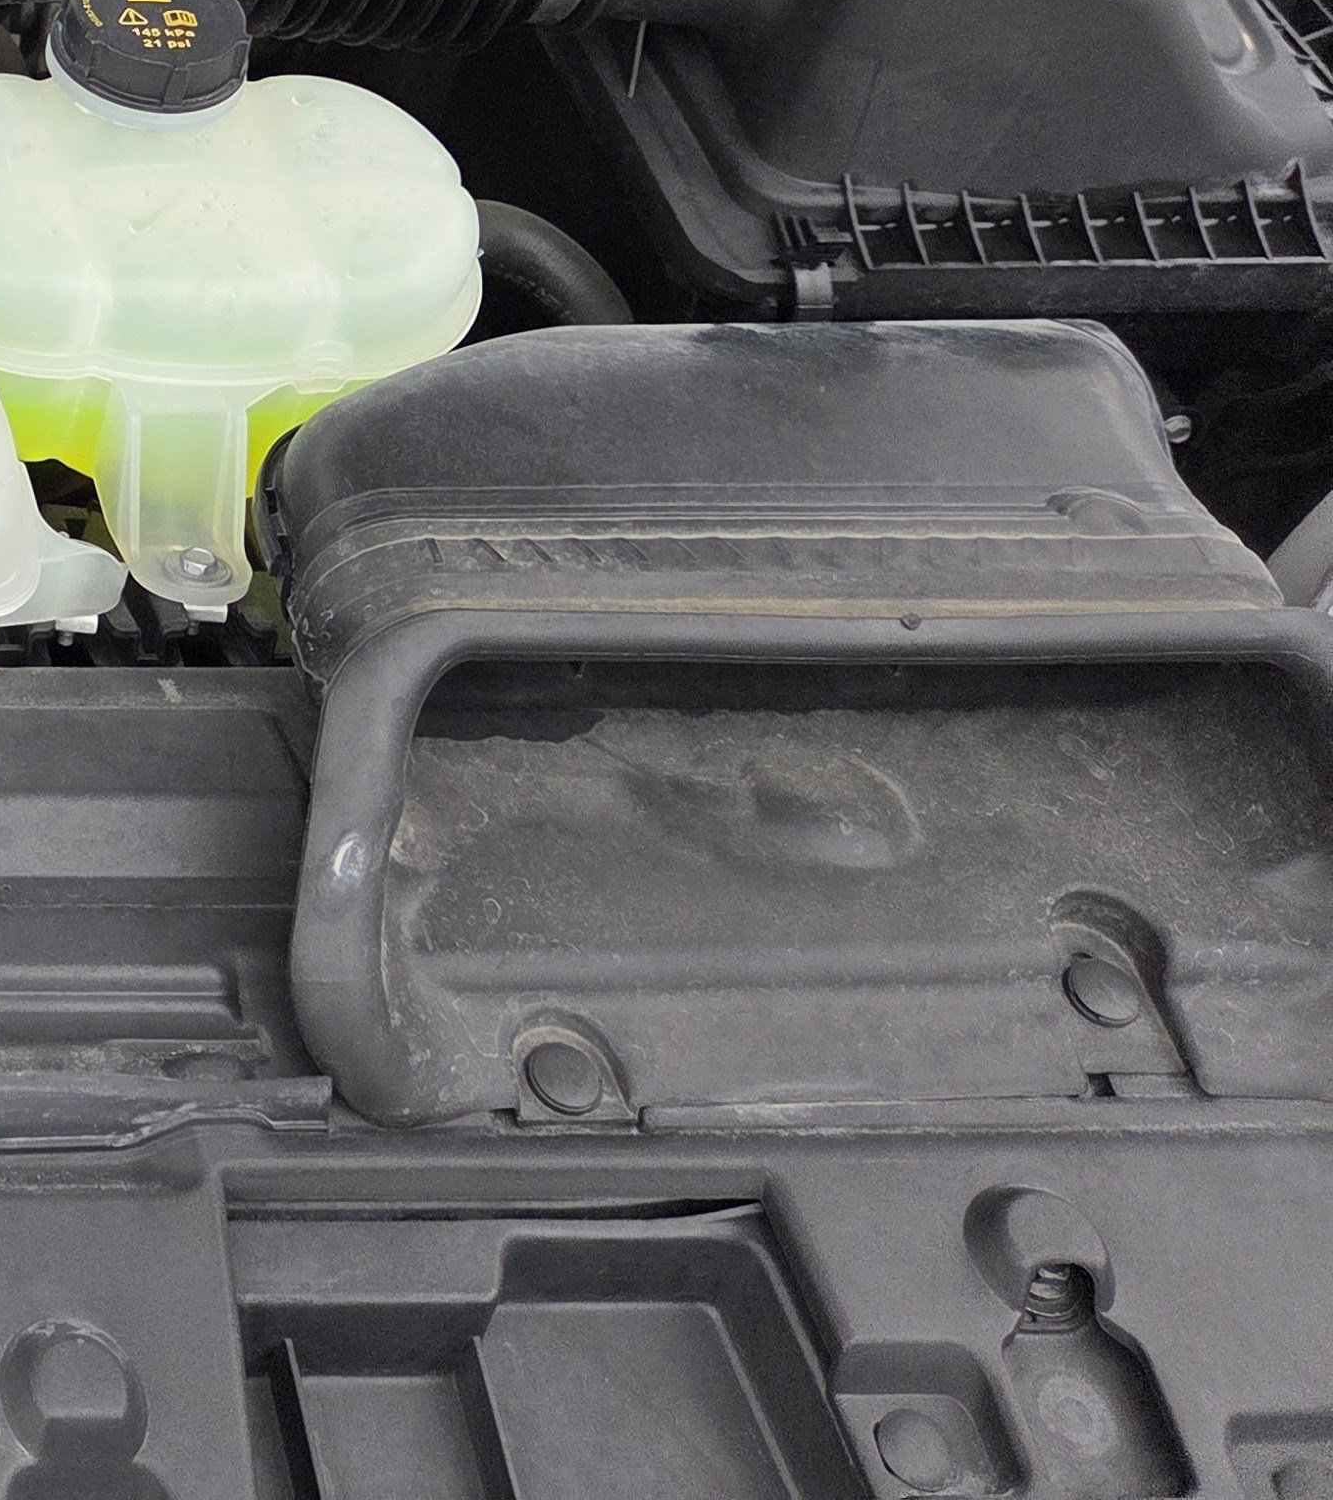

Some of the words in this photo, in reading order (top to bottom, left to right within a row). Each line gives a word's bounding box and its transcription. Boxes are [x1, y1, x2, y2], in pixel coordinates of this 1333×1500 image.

[131, 27, 161, 37] 145
[164, 27, 196, 37] kPa
[143, 38, 162, 48] 21
[166, 38, 192, 49] psi
